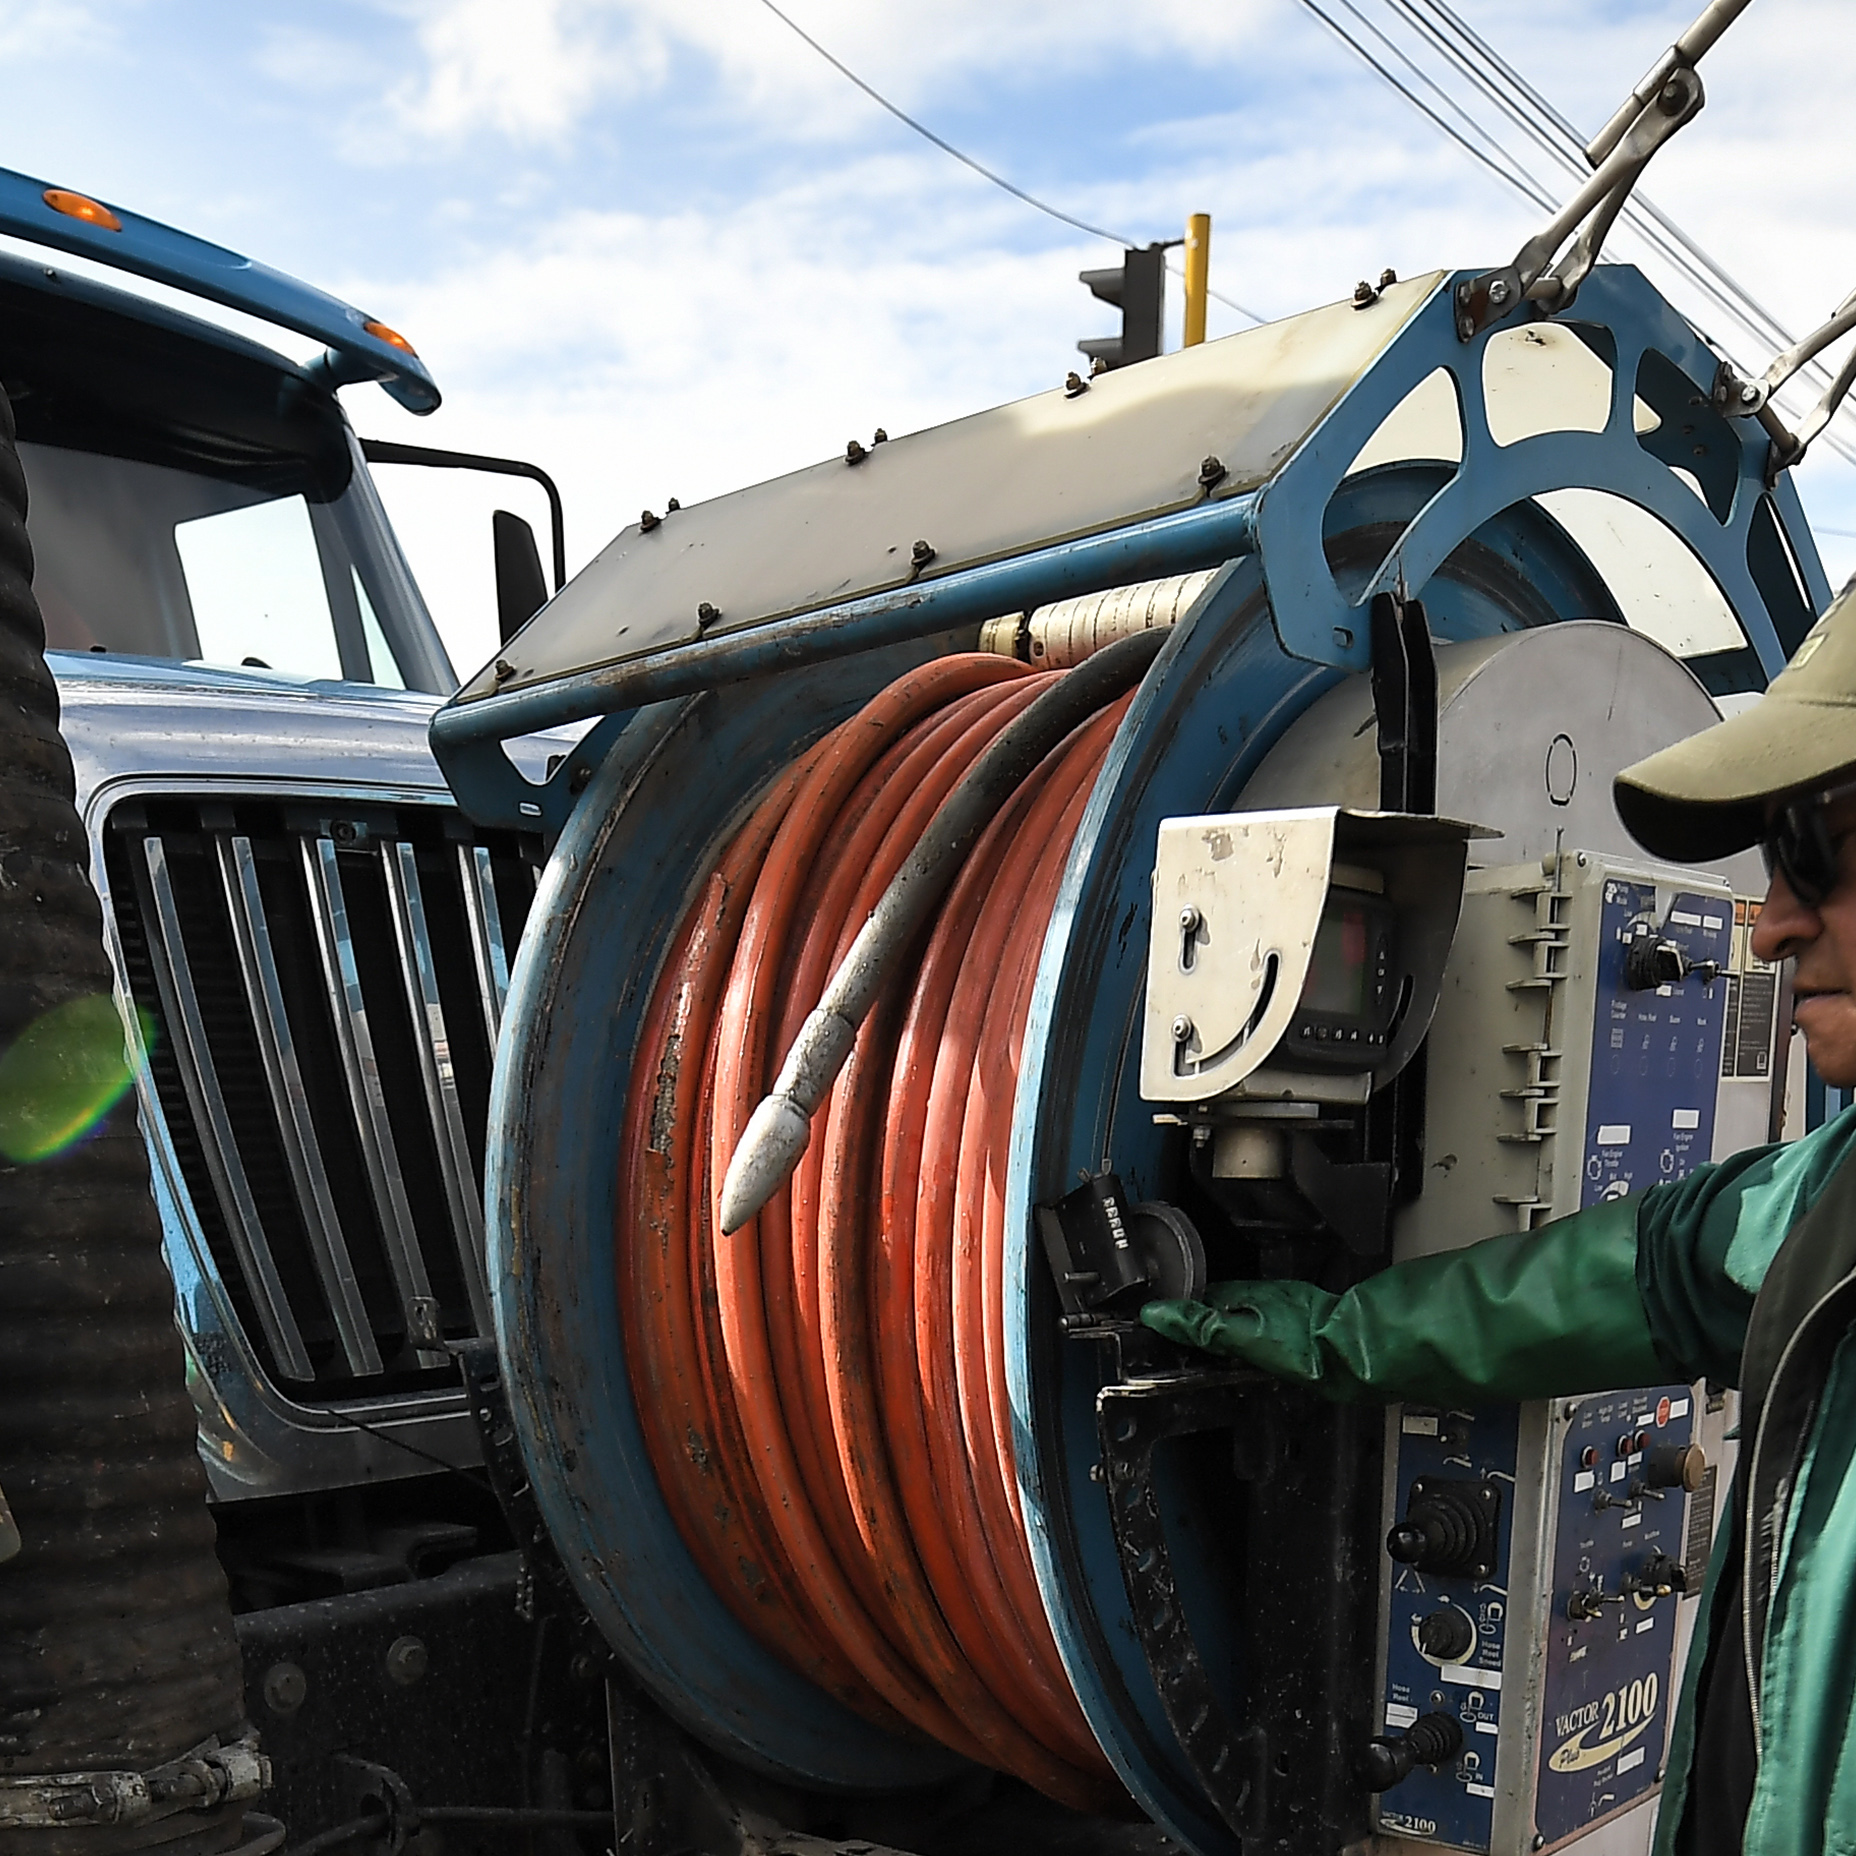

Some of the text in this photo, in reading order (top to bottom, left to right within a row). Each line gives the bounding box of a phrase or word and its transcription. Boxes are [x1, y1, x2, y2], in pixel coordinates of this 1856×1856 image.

[1555, 1672, 1658, 1740] VACTOR 2100
[1477, 1711, 1494, 1721] OUT
[1404, 1815, 1437, 1833] 2100
